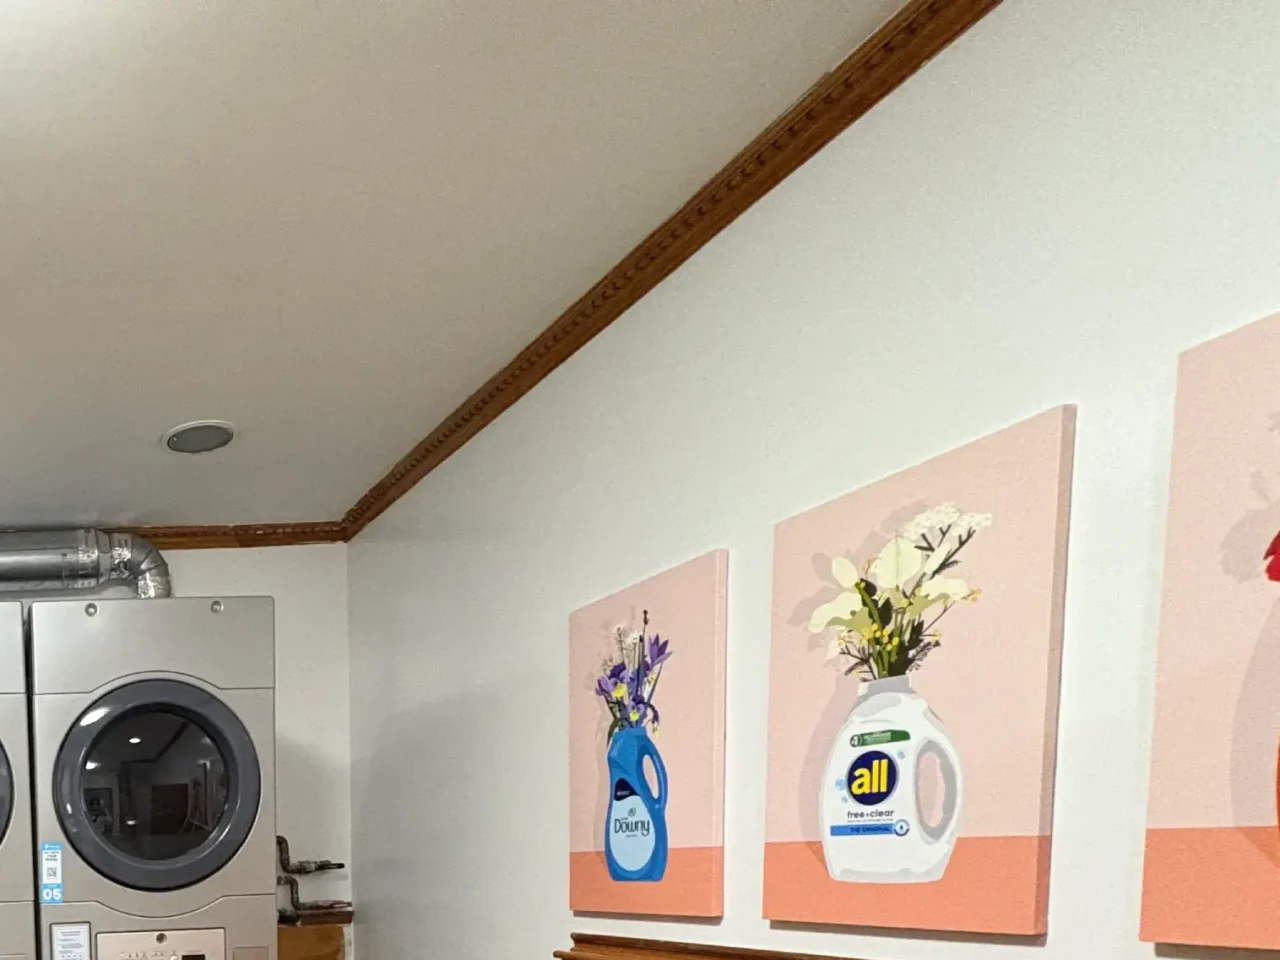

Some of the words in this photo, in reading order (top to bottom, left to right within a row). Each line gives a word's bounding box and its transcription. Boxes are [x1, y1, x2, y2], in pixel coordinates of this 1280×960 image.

[851, 758, 888, 795] all
[614, 818, 650, 837] Downy
[43, 888, 62, 901] 05
